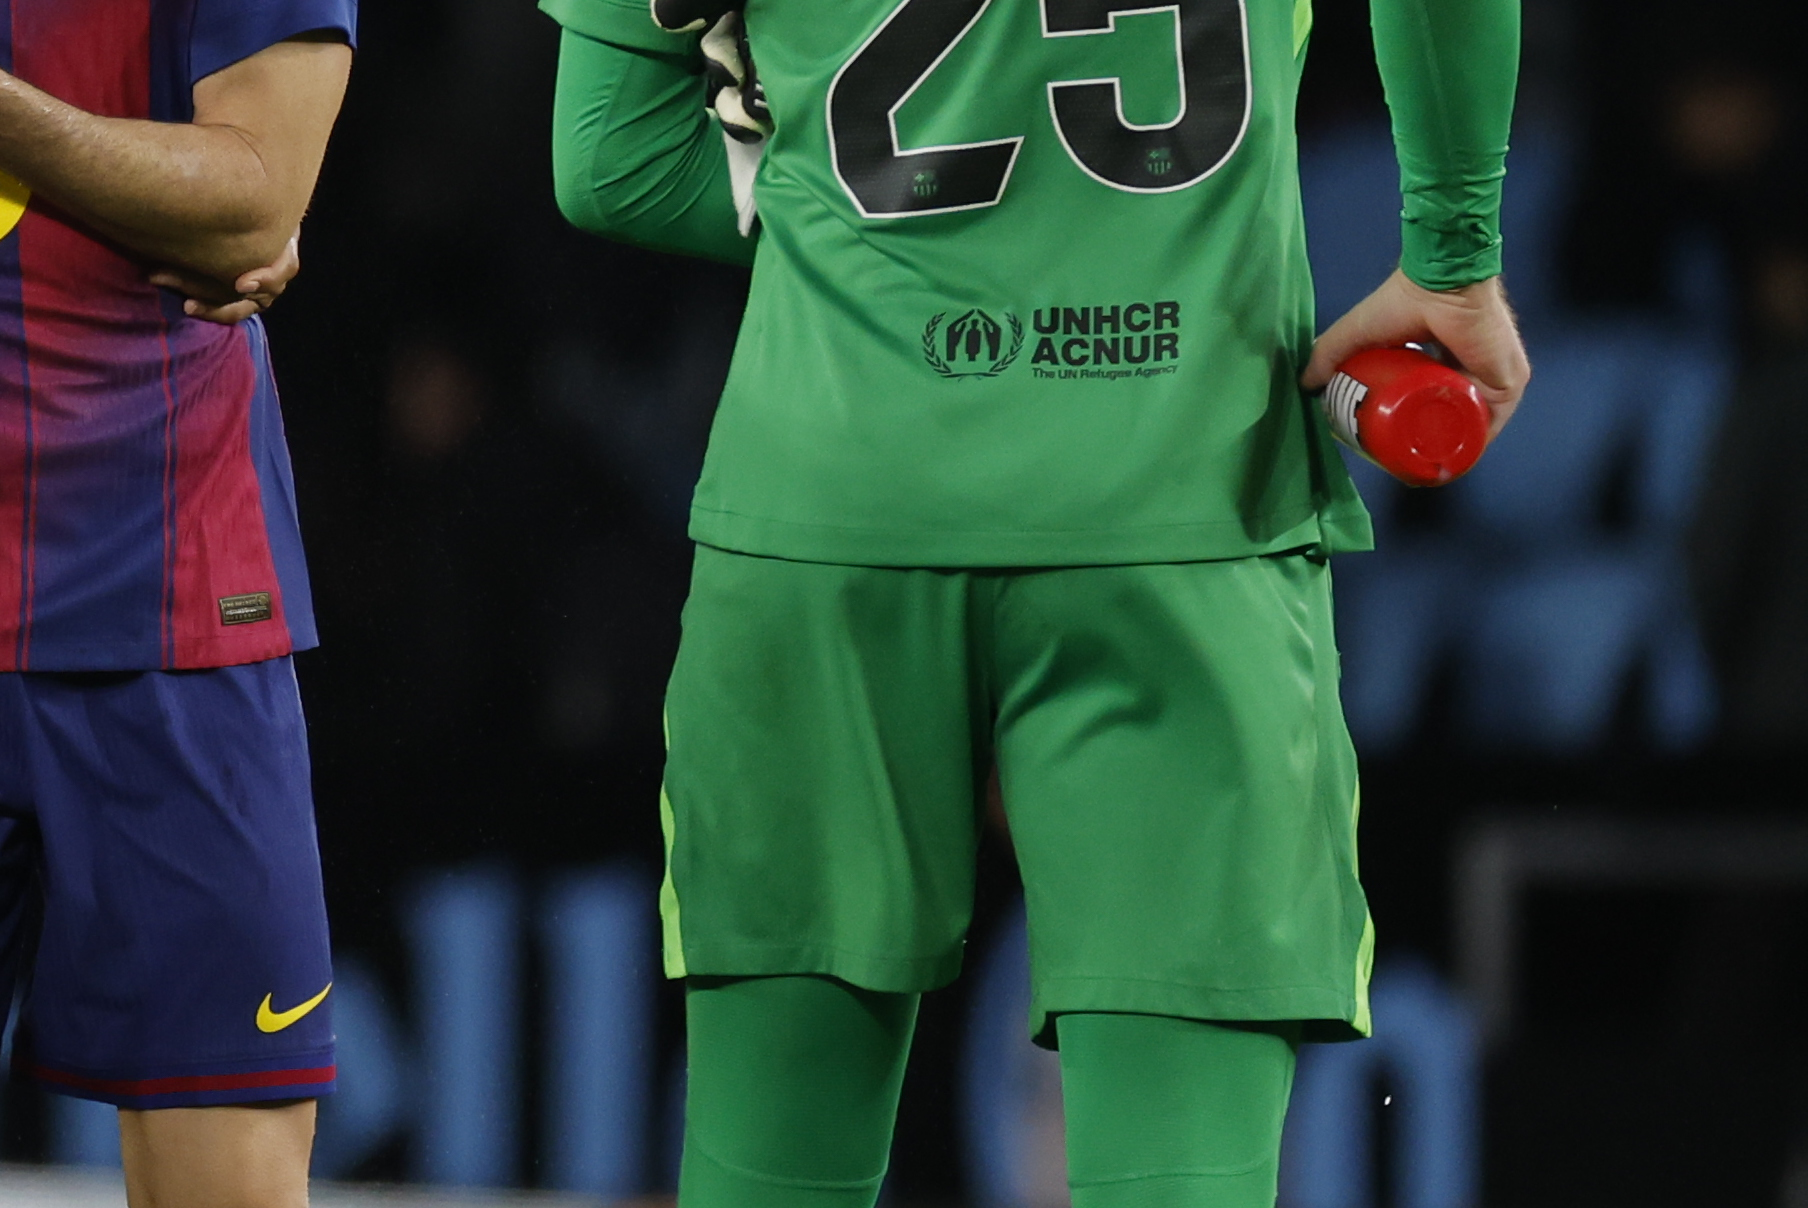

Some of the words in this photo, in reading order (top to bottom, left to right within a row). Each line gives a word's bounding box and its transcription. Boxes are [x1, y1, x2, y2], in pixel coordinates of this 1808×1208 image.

[1032, 300, 1181, 335] UNHCR
[1032, 332, 1180, 366] ACNUR
[1032, 367, 1056, 379] The
[1058, 368, 1078, 380] UN
[1080, 368, 1133, 381] Refugee
[1134, 365, 1178, 379] Agency
